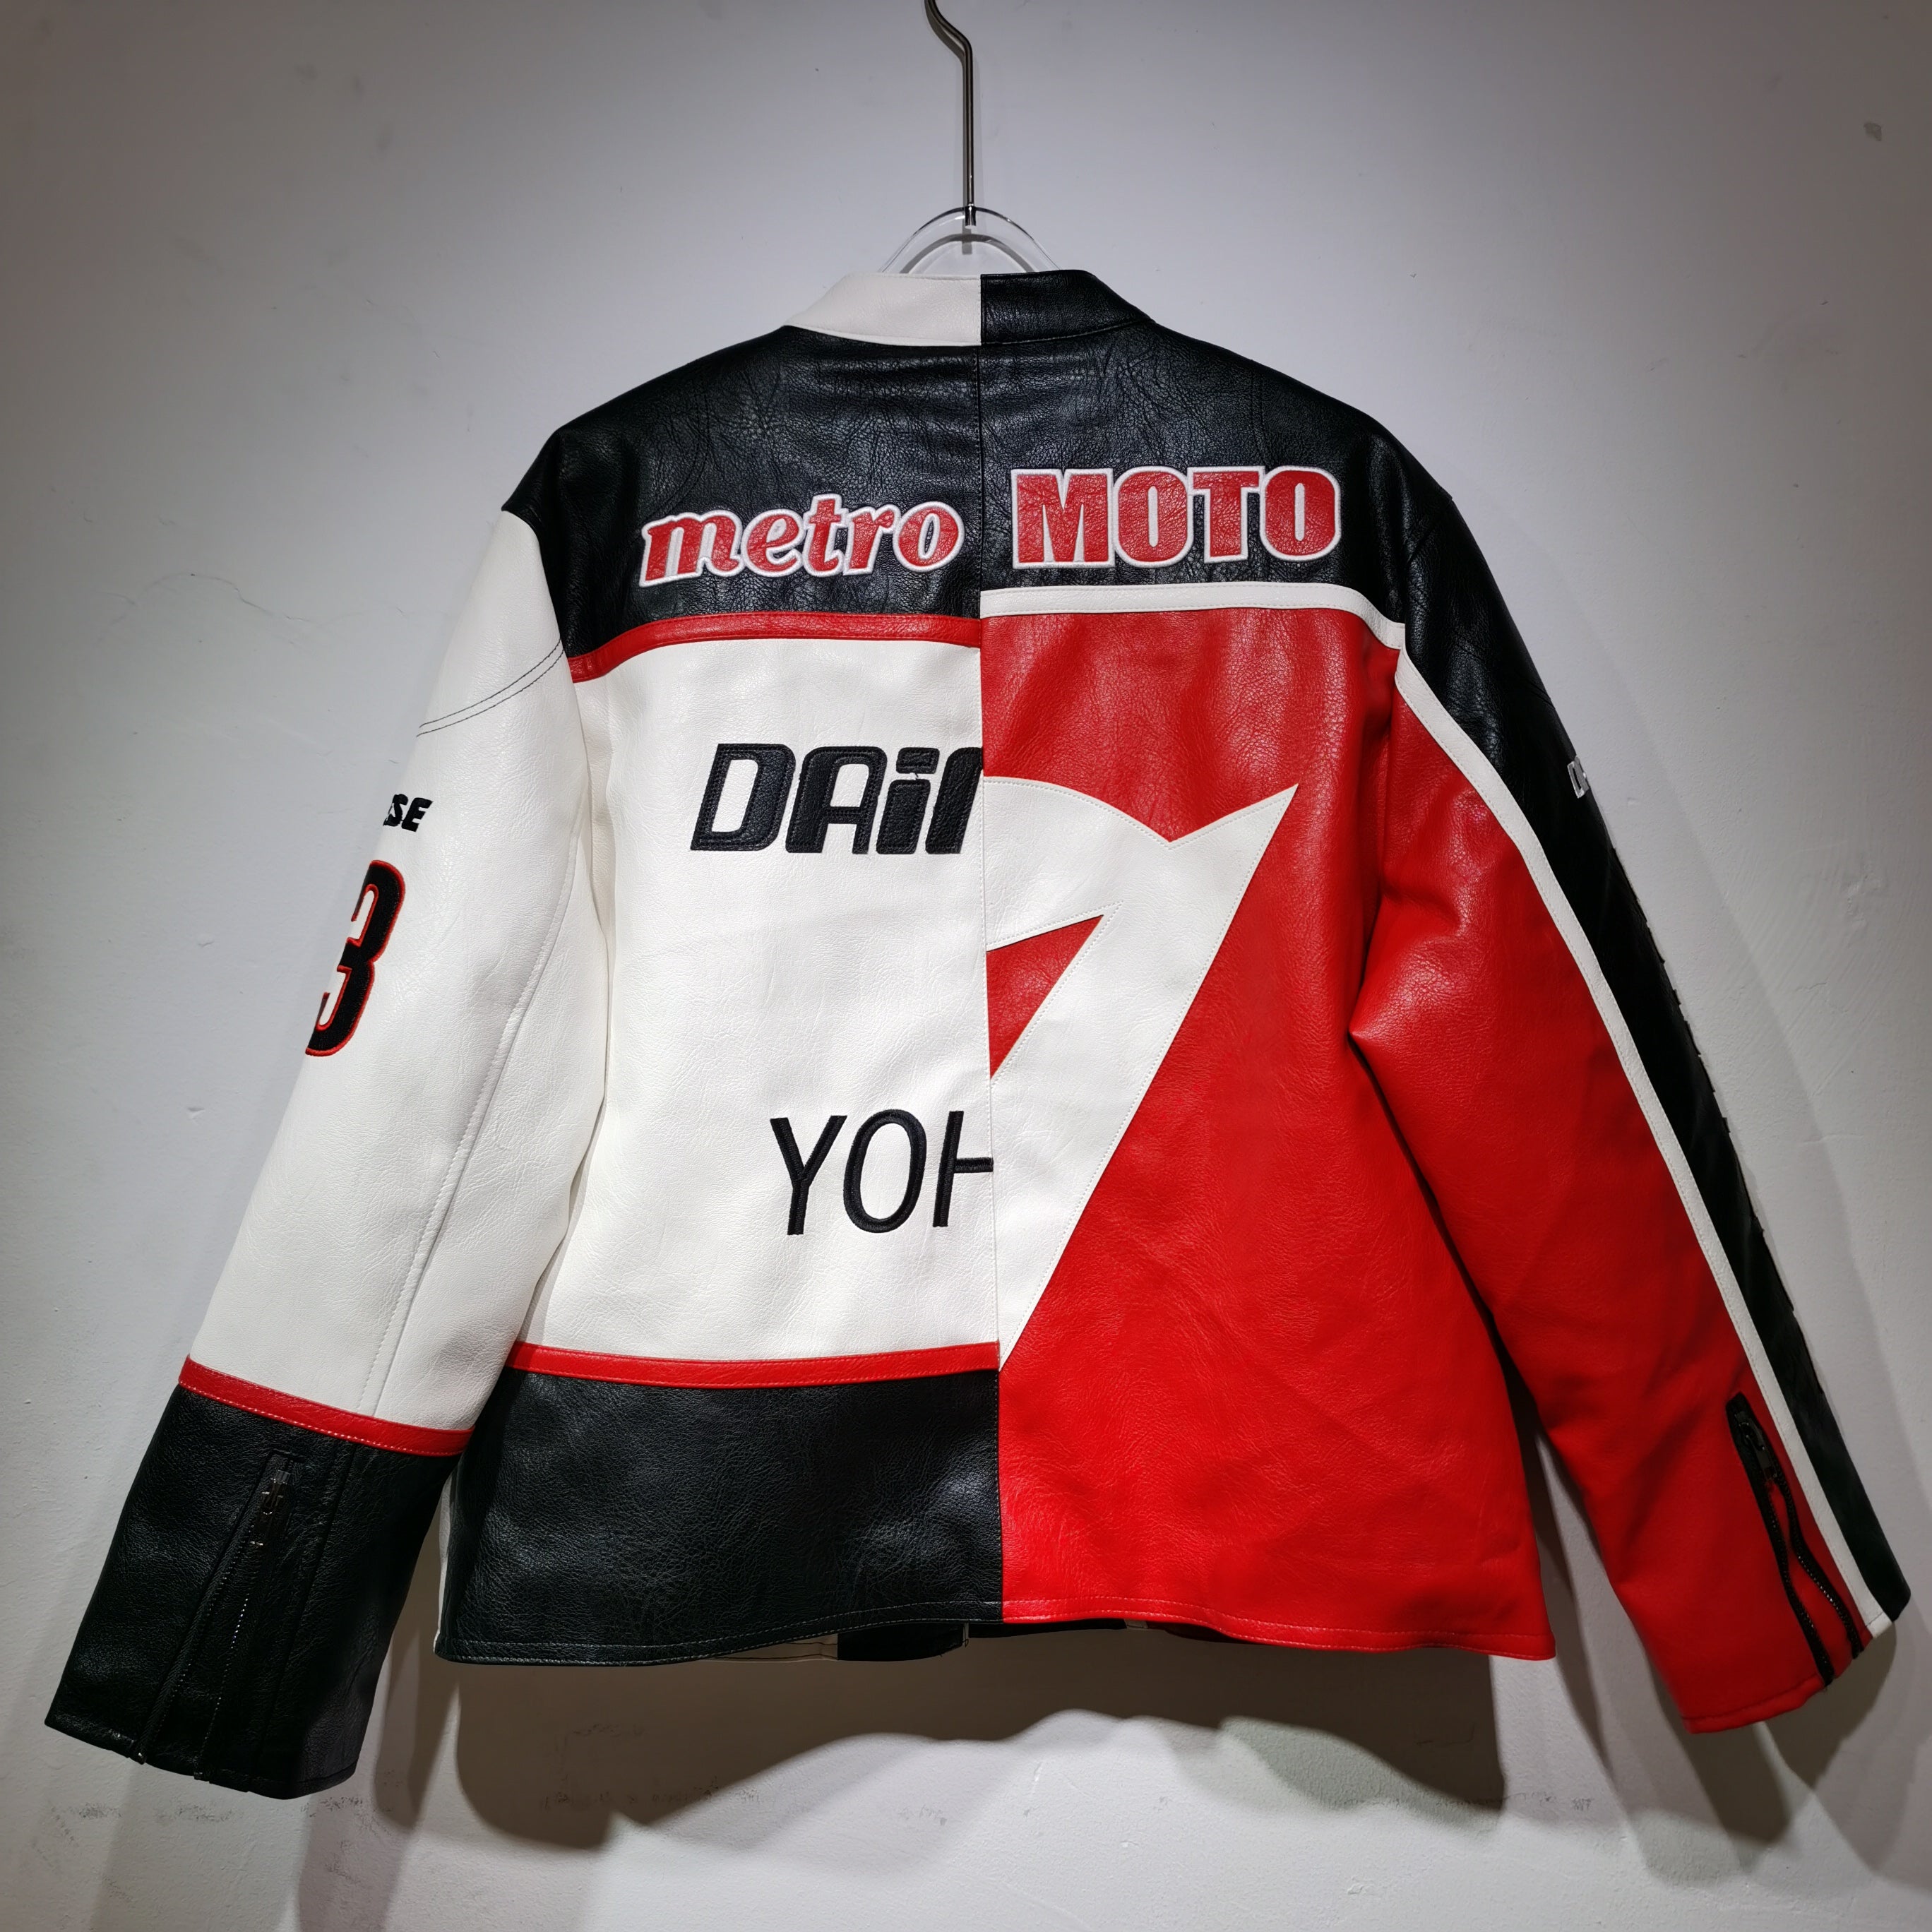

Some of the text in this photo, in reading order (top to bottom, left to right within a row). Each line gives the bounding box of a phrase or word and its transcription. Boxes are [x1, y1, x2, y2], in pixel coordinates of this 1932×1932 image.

[639, 465, 1342, 587] metro MOTO
[305, 859, 406, 1057] 3
